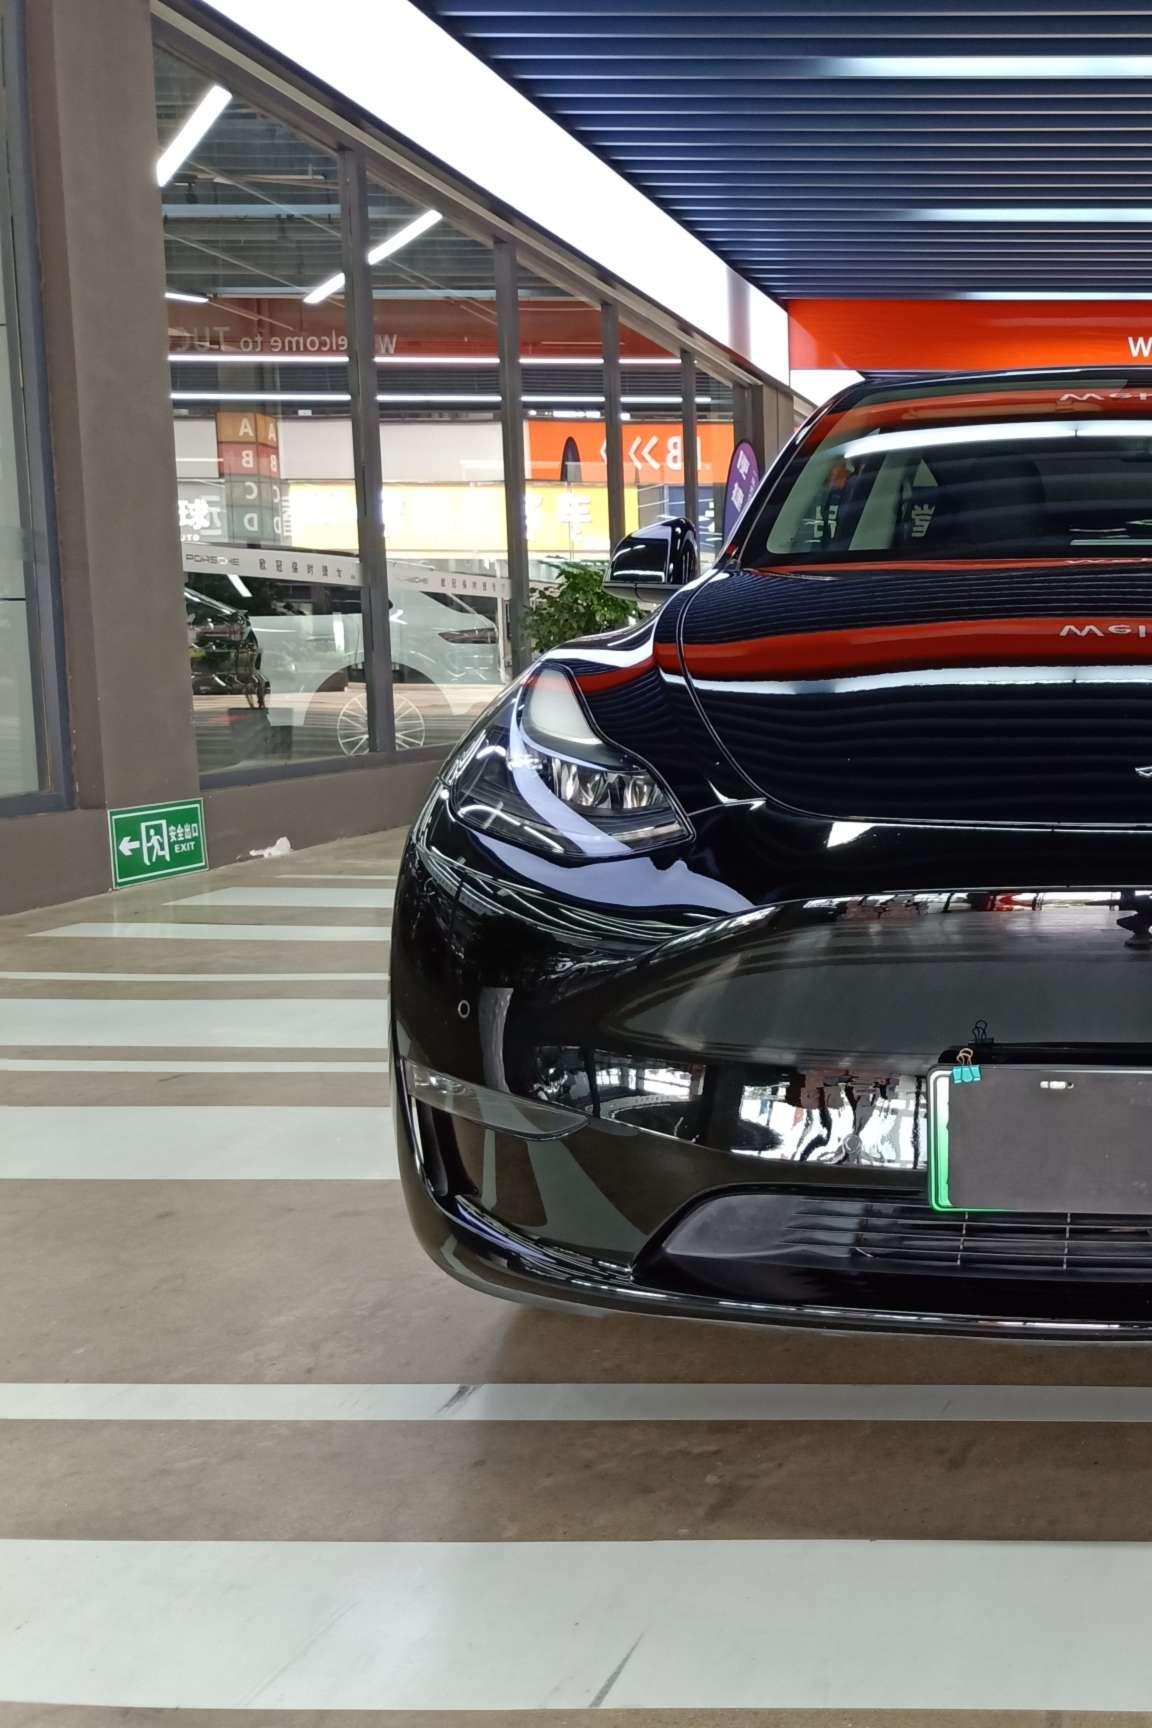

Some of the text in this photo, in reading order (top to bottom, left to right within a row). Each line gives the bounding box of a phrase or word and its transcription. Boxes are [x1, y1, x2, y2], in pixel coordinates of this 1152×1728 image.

[168, 823, 199, 842] 安全出口
[174, 841, 196, 853] EXIT
